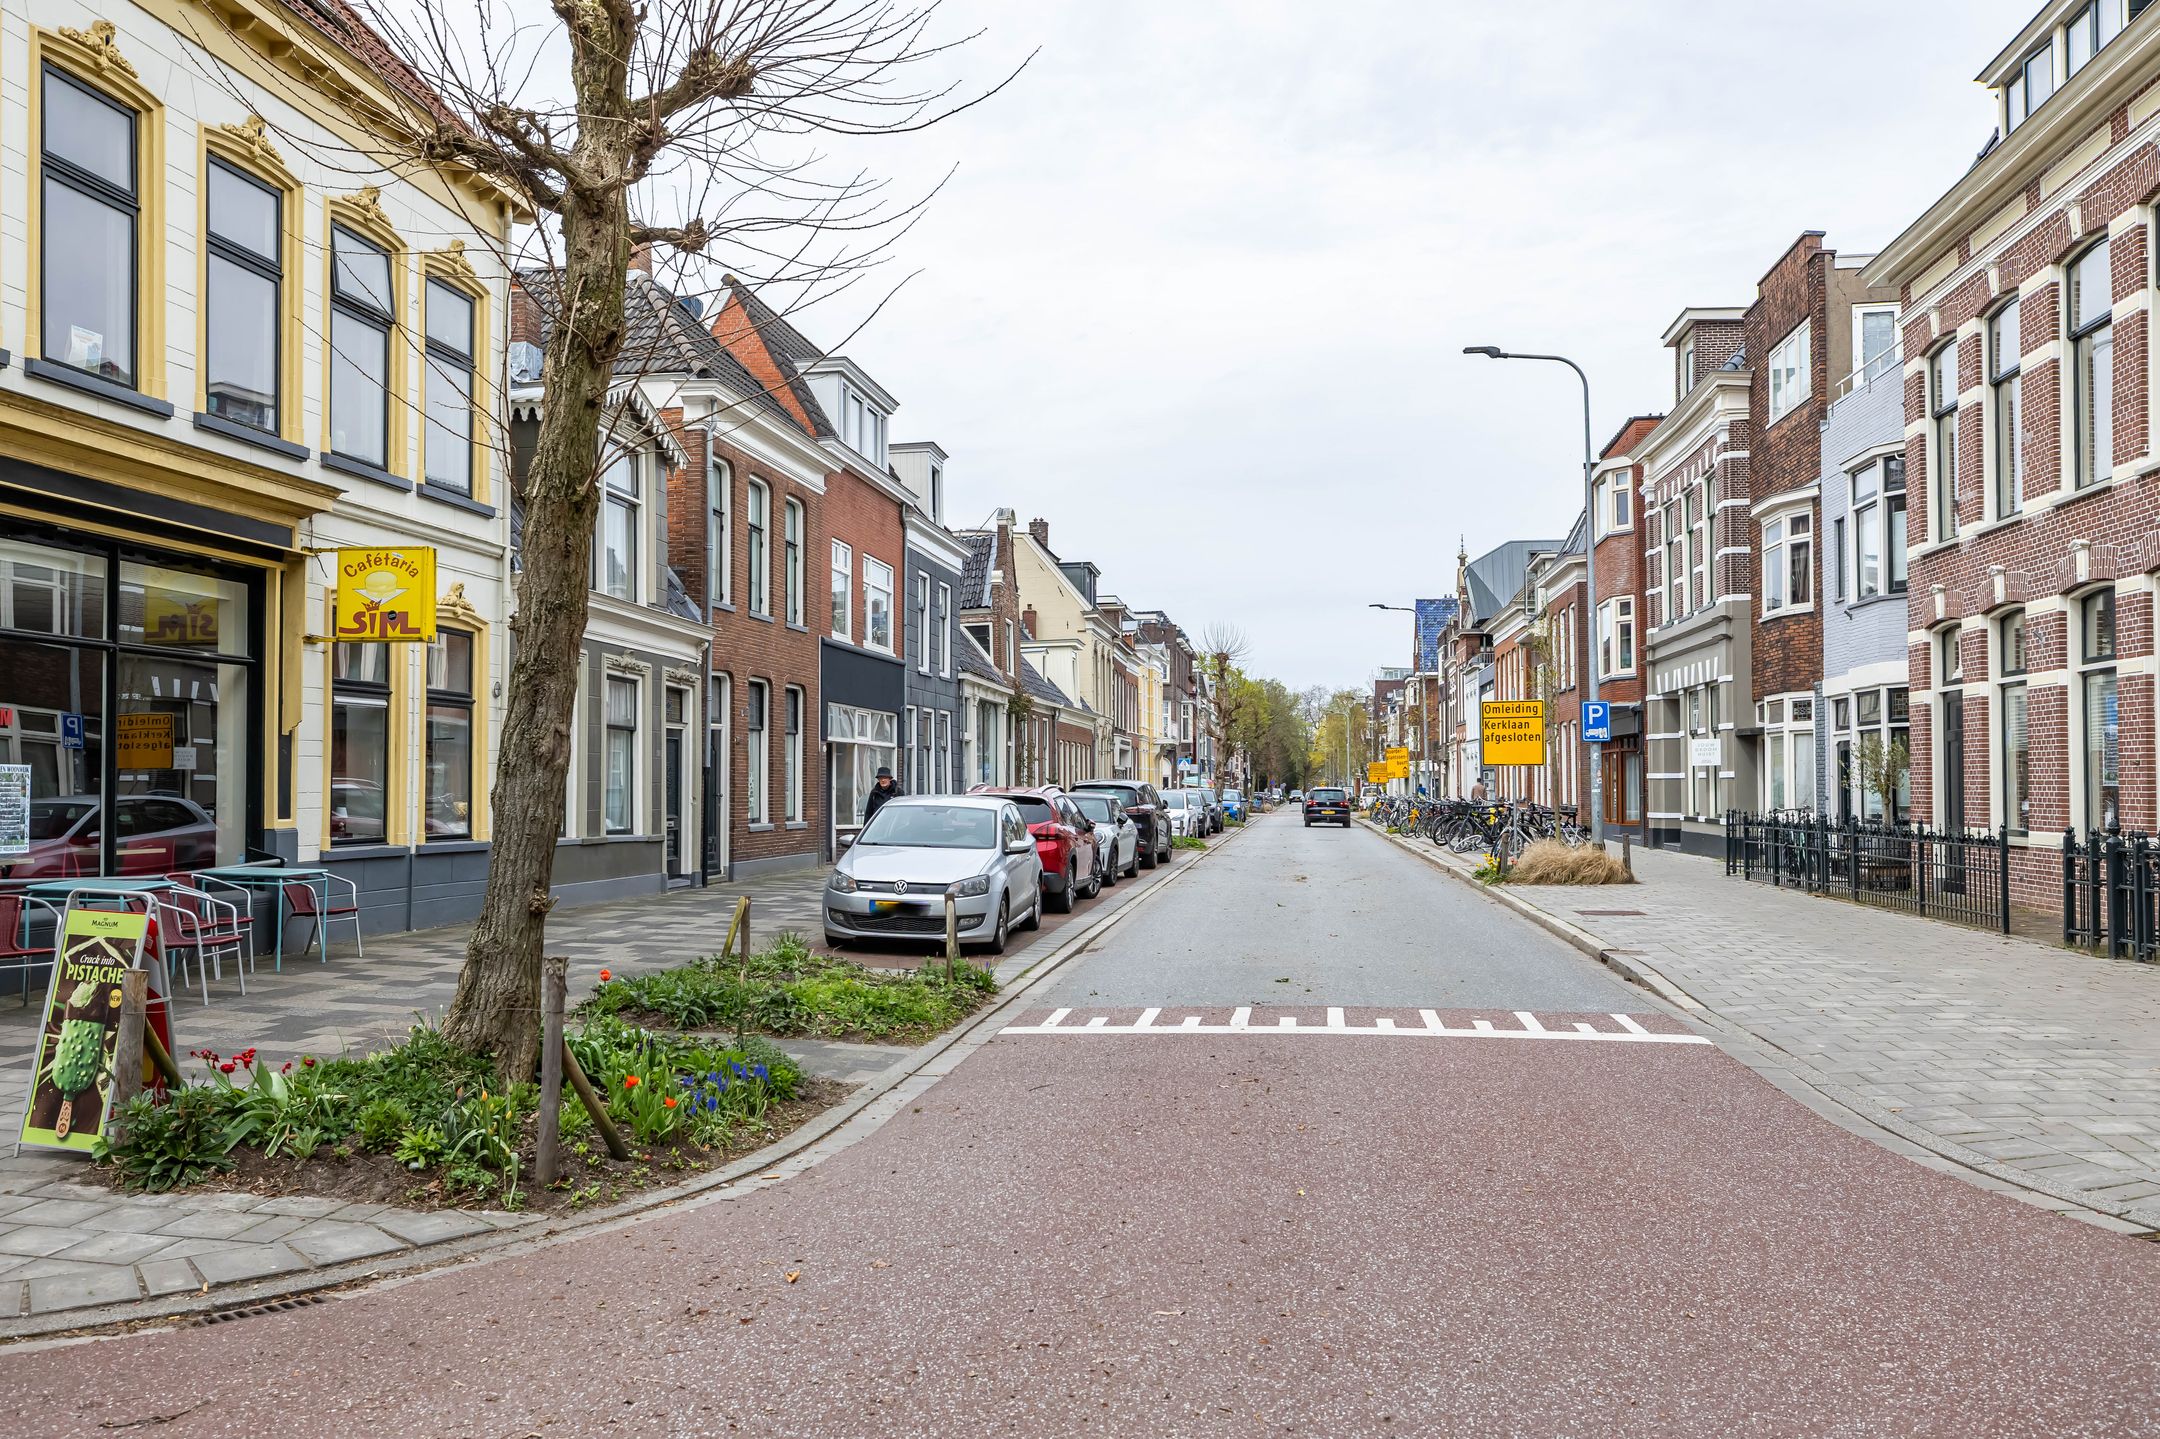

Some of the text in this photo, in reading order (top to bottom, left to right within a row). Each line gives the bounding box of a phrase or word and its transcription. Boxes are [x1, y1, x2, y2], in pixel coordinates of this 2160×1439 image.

[343, 552, 419, 578] Cafétaria
[339, 611, 421, 638] SIM
[1484, 703, 1539, 715] Omleiding
[1588, 704, 1604, 725] P
[1484, 720, 1530, 730] Kerklaan
[1484, 732, 1541, 744] afgesloten
[91, 919, 119, 928] MAGNUM
[79, 954, 115, 966] Crack into
[65, 964, 124, 984] PISTACHE
